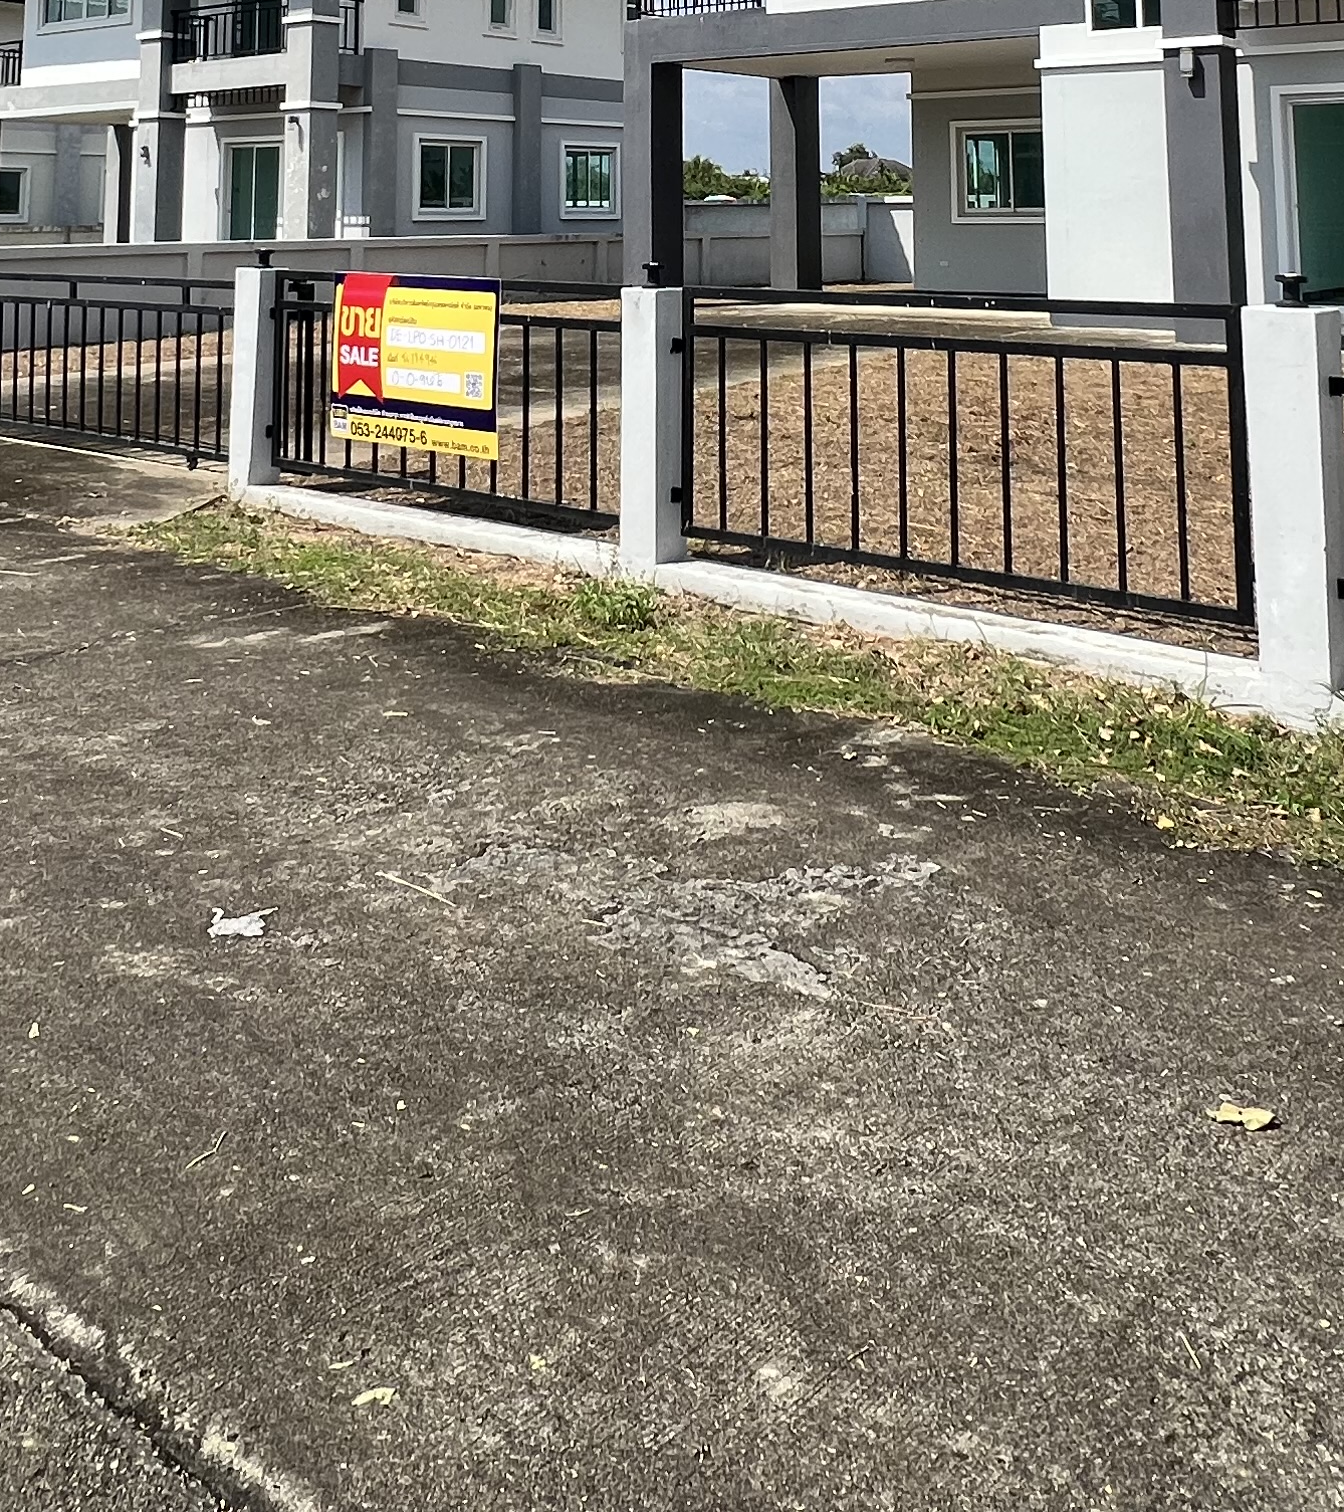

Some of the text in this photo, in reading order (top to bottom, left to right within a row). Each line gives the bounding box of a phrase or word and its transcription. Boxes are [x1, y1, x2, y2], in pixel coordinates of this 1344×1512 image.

[341, 305, 381, 338] ขาย
[340, 344, 380, 367] SALE
[350, 421, 490, 455] 053-244075-6 www.bam.co.th
